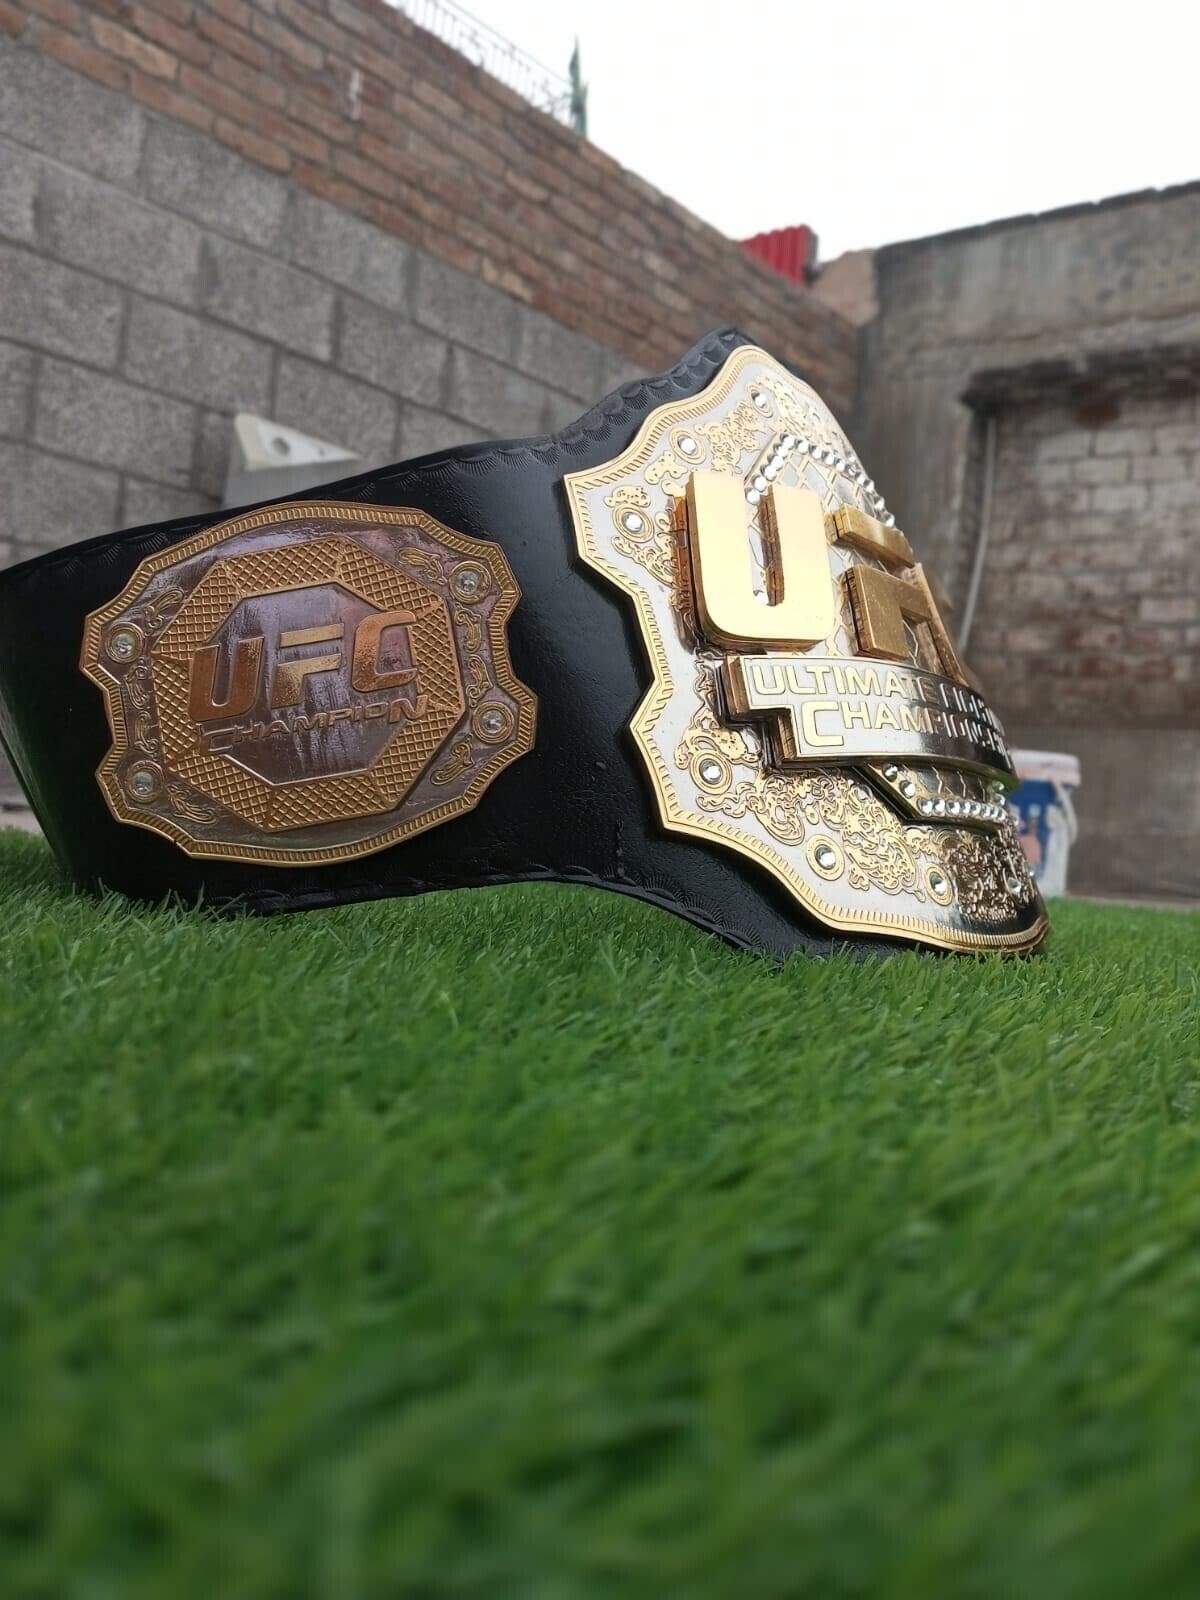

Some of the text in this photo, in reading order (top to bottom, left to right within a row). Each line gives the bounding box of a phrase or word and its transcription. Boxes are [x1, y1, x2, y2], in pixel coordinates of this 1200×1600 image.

[680, 470, 968, 686] UF
[187, 610, 419, 722] UFC
[752, 664, 939, 706] ULTIMATE
[195, 694, 429, 757] CHAMPION
[801, 699, 1012, 769] CHAMPION
